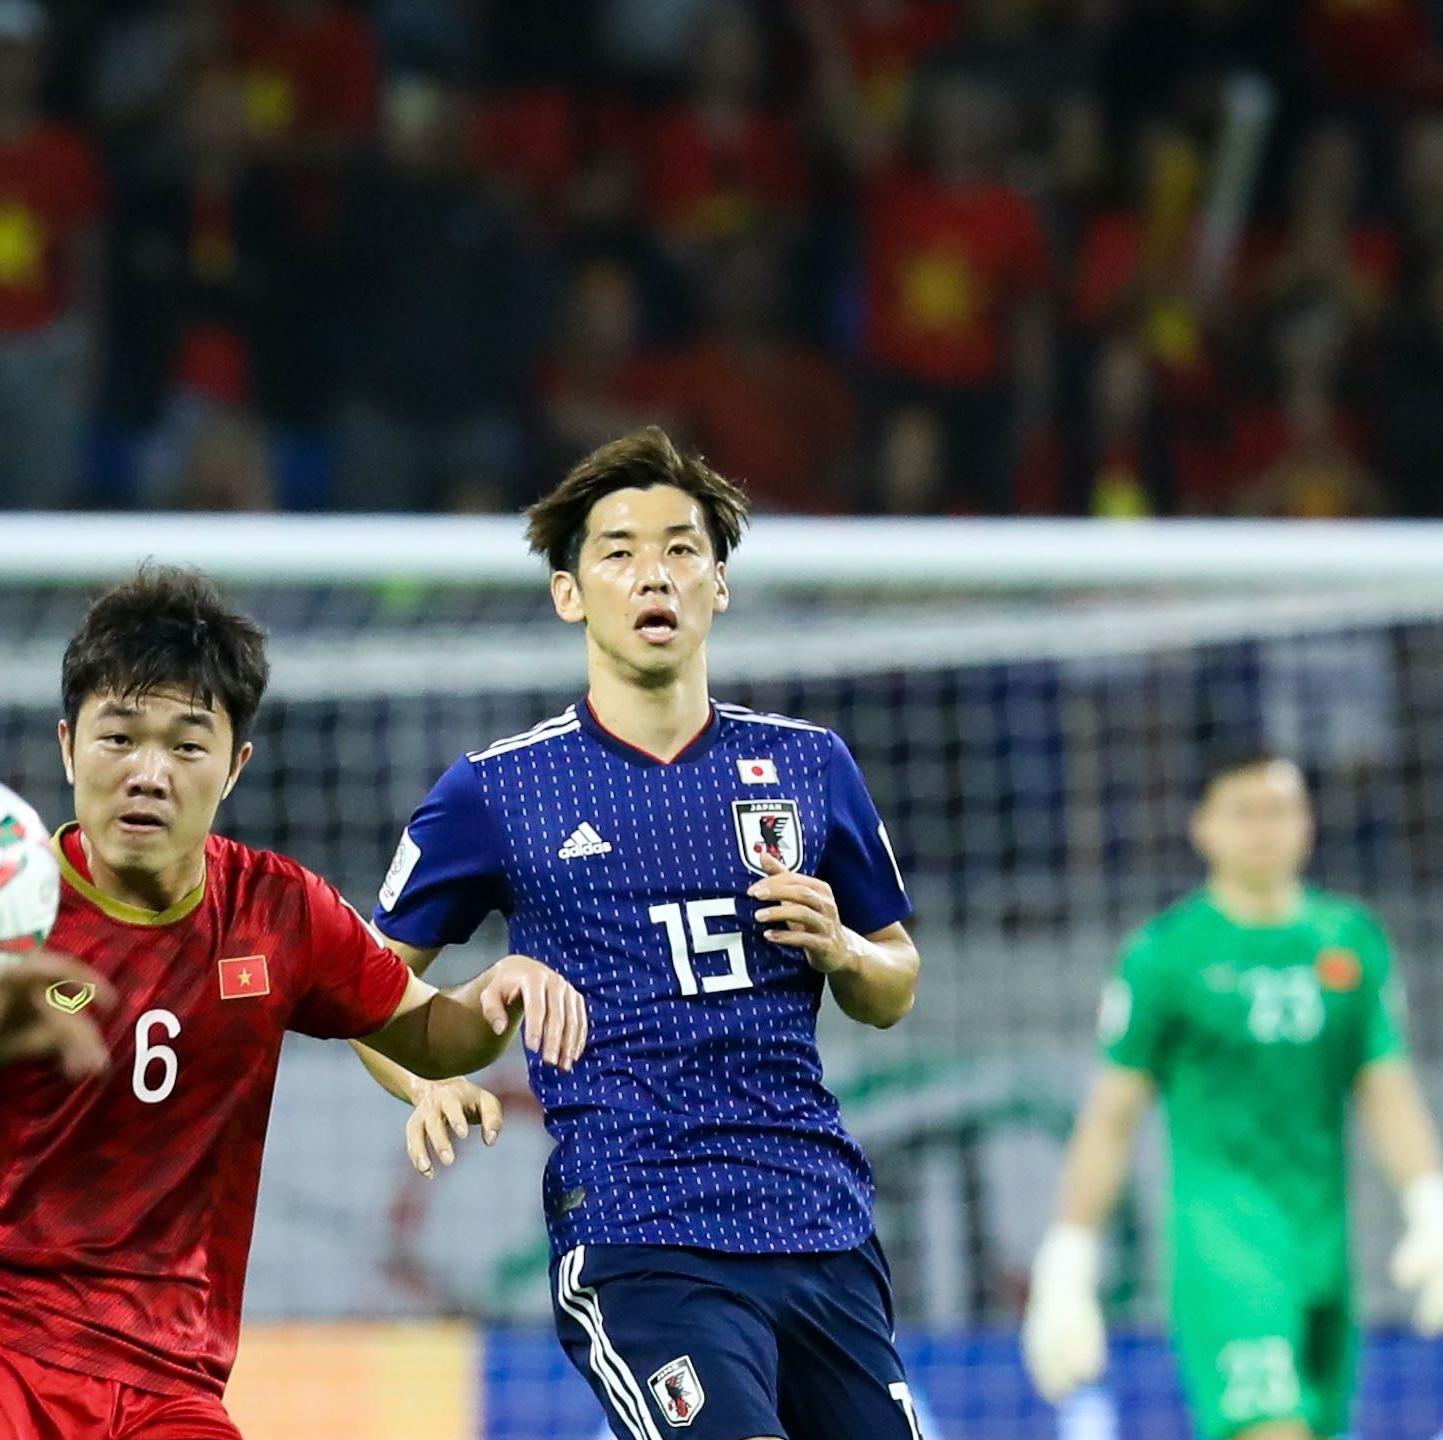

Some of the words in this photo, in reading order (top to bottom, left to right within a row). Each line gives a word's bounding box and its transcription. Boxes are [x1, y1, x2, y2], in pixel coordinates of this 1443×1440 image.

[558, 841, 612, 859] adidas
[749, 803, 783, 812] JAPAN
[648, 897, 754, 996] 15
[132, 1008, 181, 1103] 6
[1215, 1335, 1300, 1421] 23
